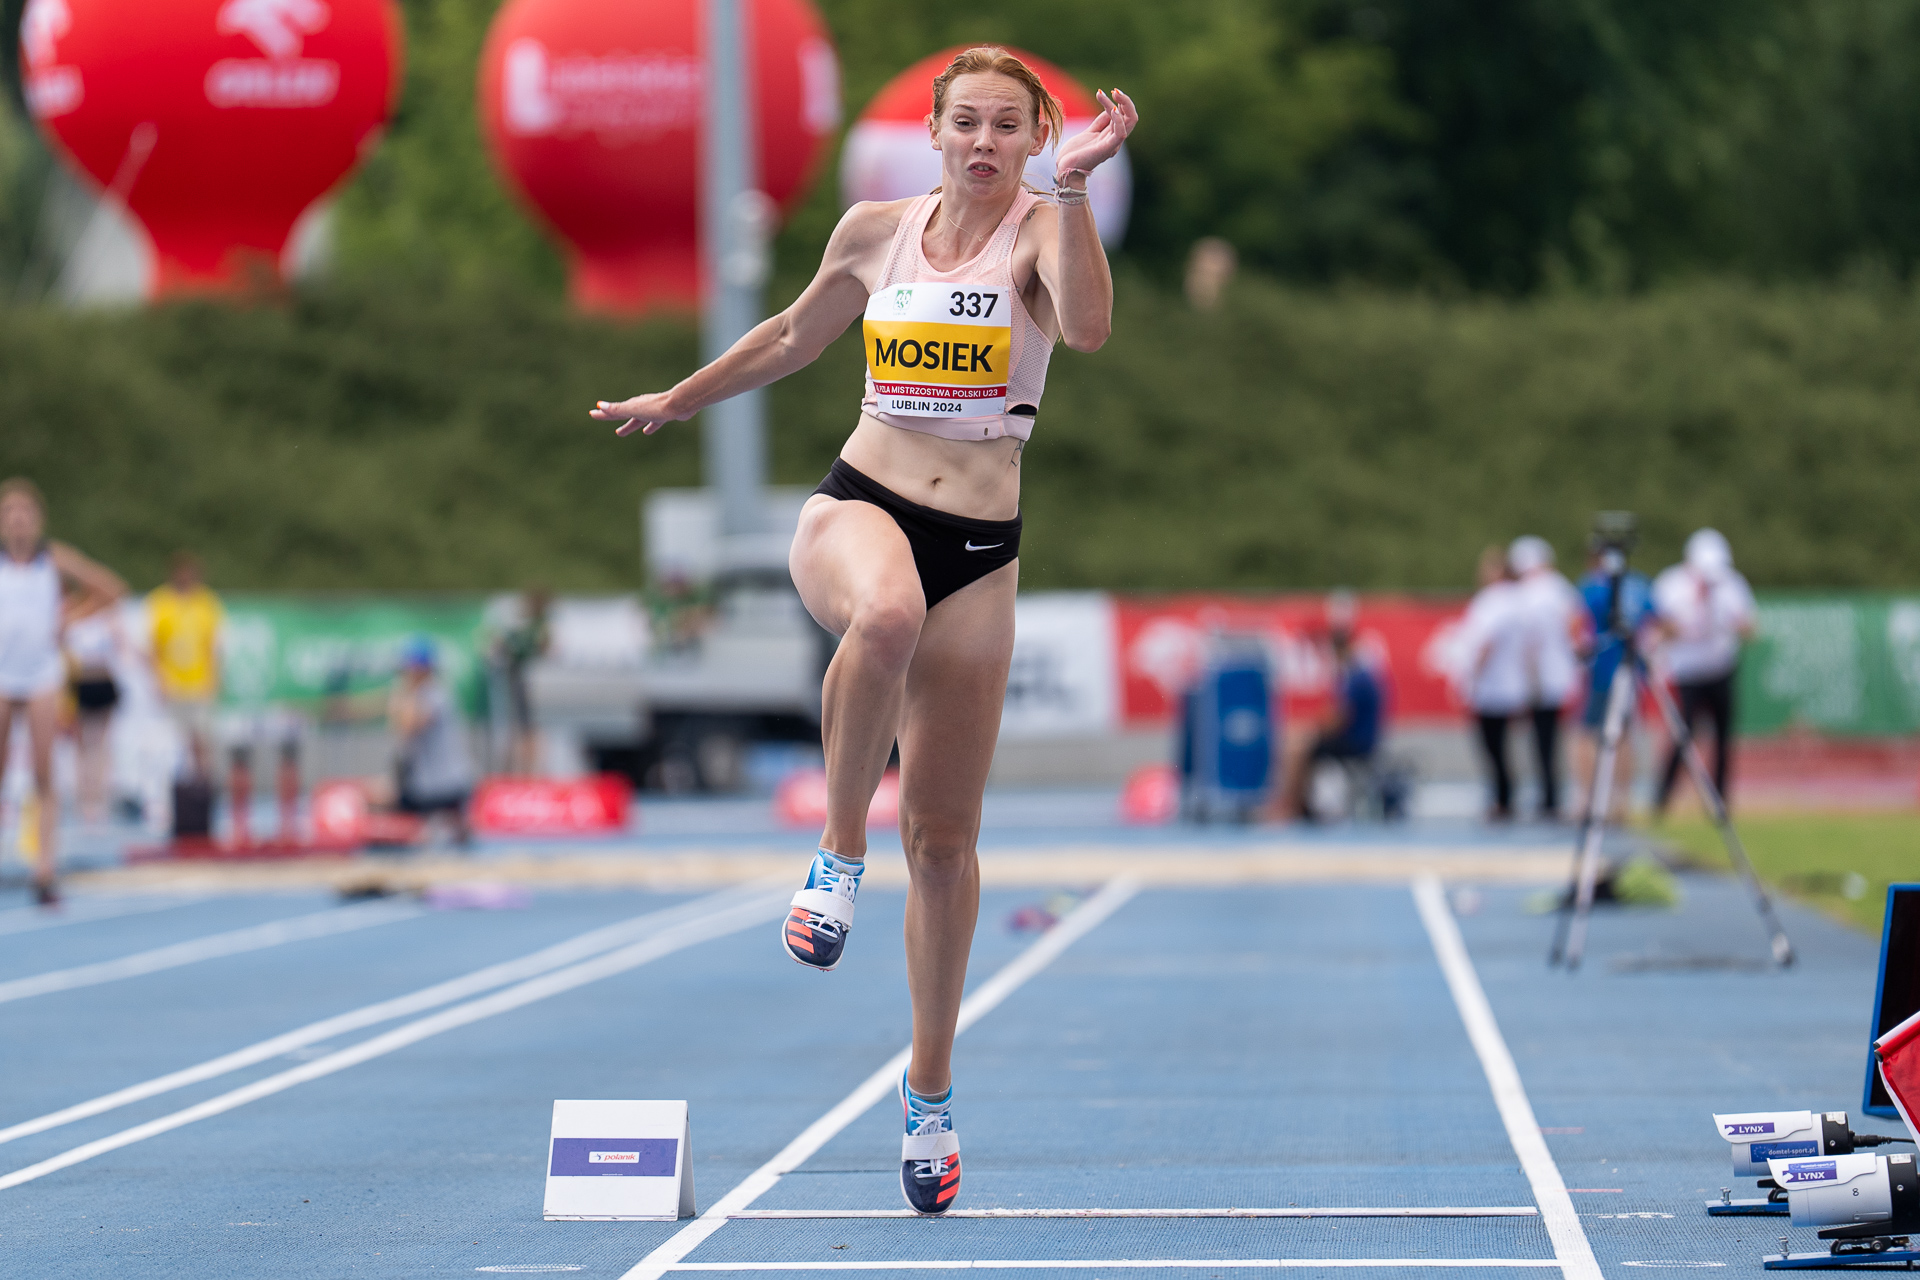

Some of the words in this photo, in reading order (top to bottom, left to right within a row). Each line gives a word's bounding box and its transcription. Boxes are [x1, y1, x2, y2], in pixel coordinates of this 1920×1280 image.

[949, 291, 999, 318] 337
[875, 338, 993, 372] MOSIEK
[891, 386, 950, 397] MISTRZOSTWA
[952, 390, 981, 398] POLSKI
[983, 389, 998, 397] U23
[892, 400, 930, 411] LUBLIN
[933, 402, 962, 412] 2024
[1739, 1125, 1764, 1133] LYNX
[1768, 1147, 1816, 1156] domtel-sport.pl
[604, 1153, 636, 1161] polanik
[1798, 1172, 1825, 1180] LYNX
[1852, 1188, 1859, 1196] 8
